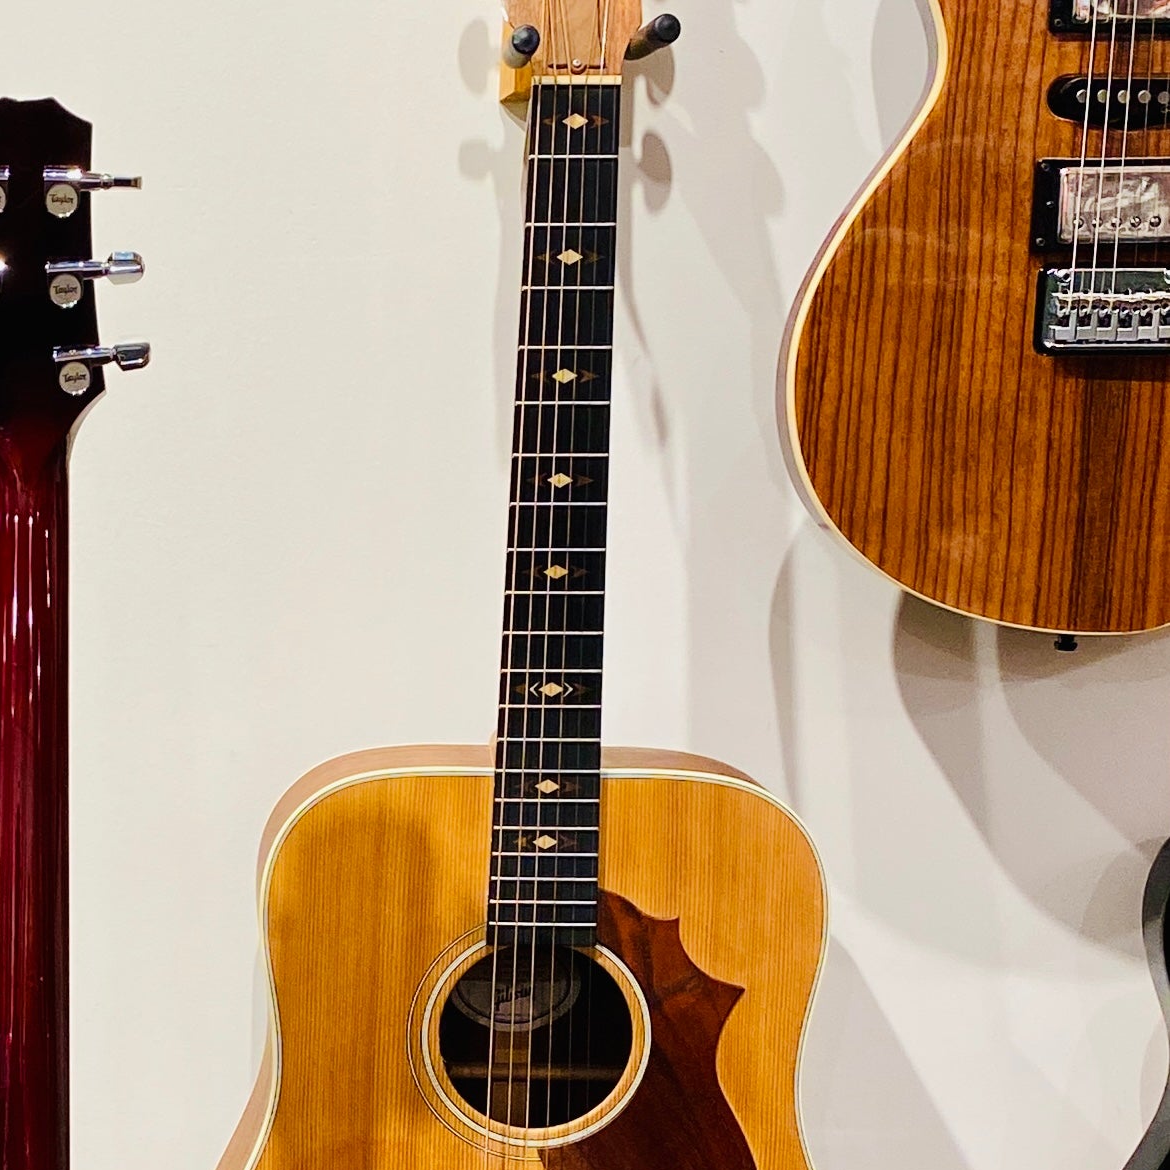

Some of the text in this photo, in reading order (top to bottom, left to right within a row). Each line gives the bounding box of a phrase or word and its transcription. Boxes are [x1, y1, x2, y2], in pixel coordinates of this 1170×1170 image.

[49, 193, 75, 206] Taylor
[52, 284, 78, 297] Taylor
[62, 372, 88, 385] Taylor
